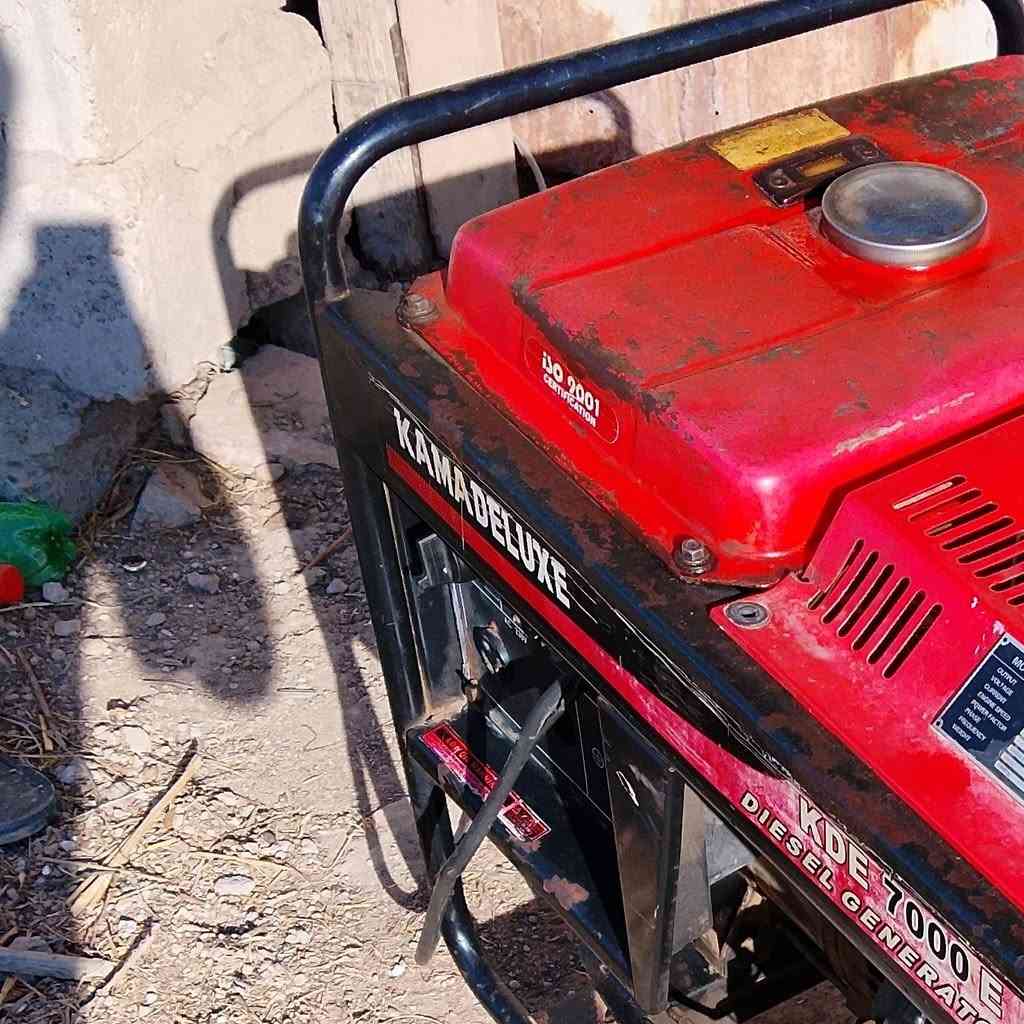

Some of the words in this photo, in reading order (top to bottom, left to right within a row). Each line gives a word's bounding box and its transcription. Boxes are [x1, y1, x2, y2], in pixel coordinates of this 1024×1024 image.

[543, 373, 597, 428] CERTIFICATION
[393, 407, 571, 609] KAMADELUXE
[741, 791, 836, 890] DIESEL
[799, 797, 870, 889] KDE
[881, 869, 970, 983] 7000
[978, 965, 1004, 1019] E
